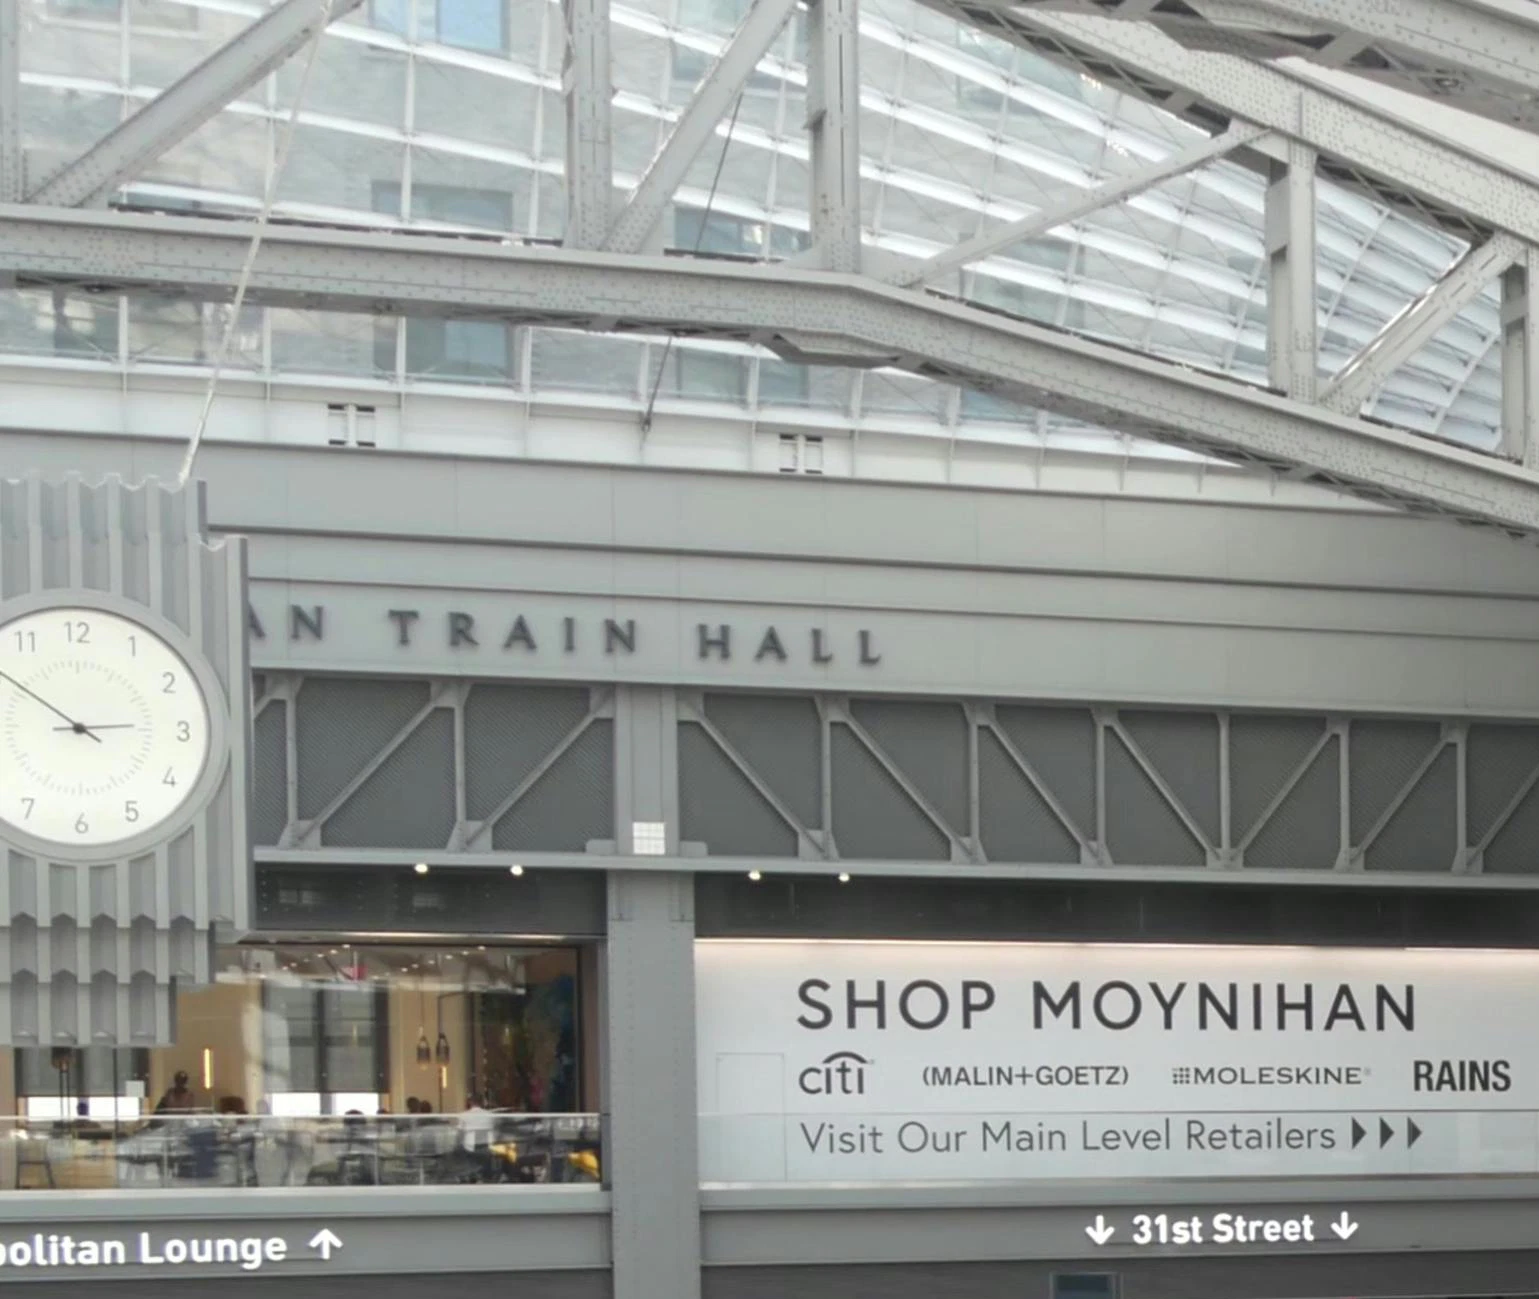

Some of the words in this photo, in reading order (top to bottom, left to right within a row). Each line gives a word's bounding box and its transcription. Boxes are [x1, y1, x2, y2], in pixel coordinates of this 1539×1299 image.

[14, 630, 36, 653] 11
[64, 621, 91, 644] 12
[389, 609, 637, 654] TRAIN
[697, 623, 881, 666] HALL
[128, 635, 136, 657] 1
[162, 671, 176, 694] 2
[176, 720, 191, 743] 3
[161, 766, 177, 788] 4
[21, 797, 35, 820] 7
[124, 800, 139, 823] 5
[74, 812, 89, 834] 6
[796, 978, 996, 1031] SHOP
[1032, 979, 1414, 1032] MOYNIHAN
[798, 1050, 868, 1095] citi
[922, 1065, 1129, 1087] (MALIN+GOETZ)
[1193, 1066, 1363, 1086] MOLESKINE
[1413, 1059, 1512, 1093] RAINS
[800, 1122, 883, 1154] Visit
[897, 1120, 968, 1153] Our
[981, 1120, 1067, 1152] Main
[1082, 1117, 1171, 1152] Level
[1186, 1116, 1337, 1151] Retailers
[1132, 1213, 1204, 1245] 31st
[1212, 1212, 1315, 1244] Street
[0, 1233, 125, 1266] olitan
[140, 1231, 288, 1271] Lounge
